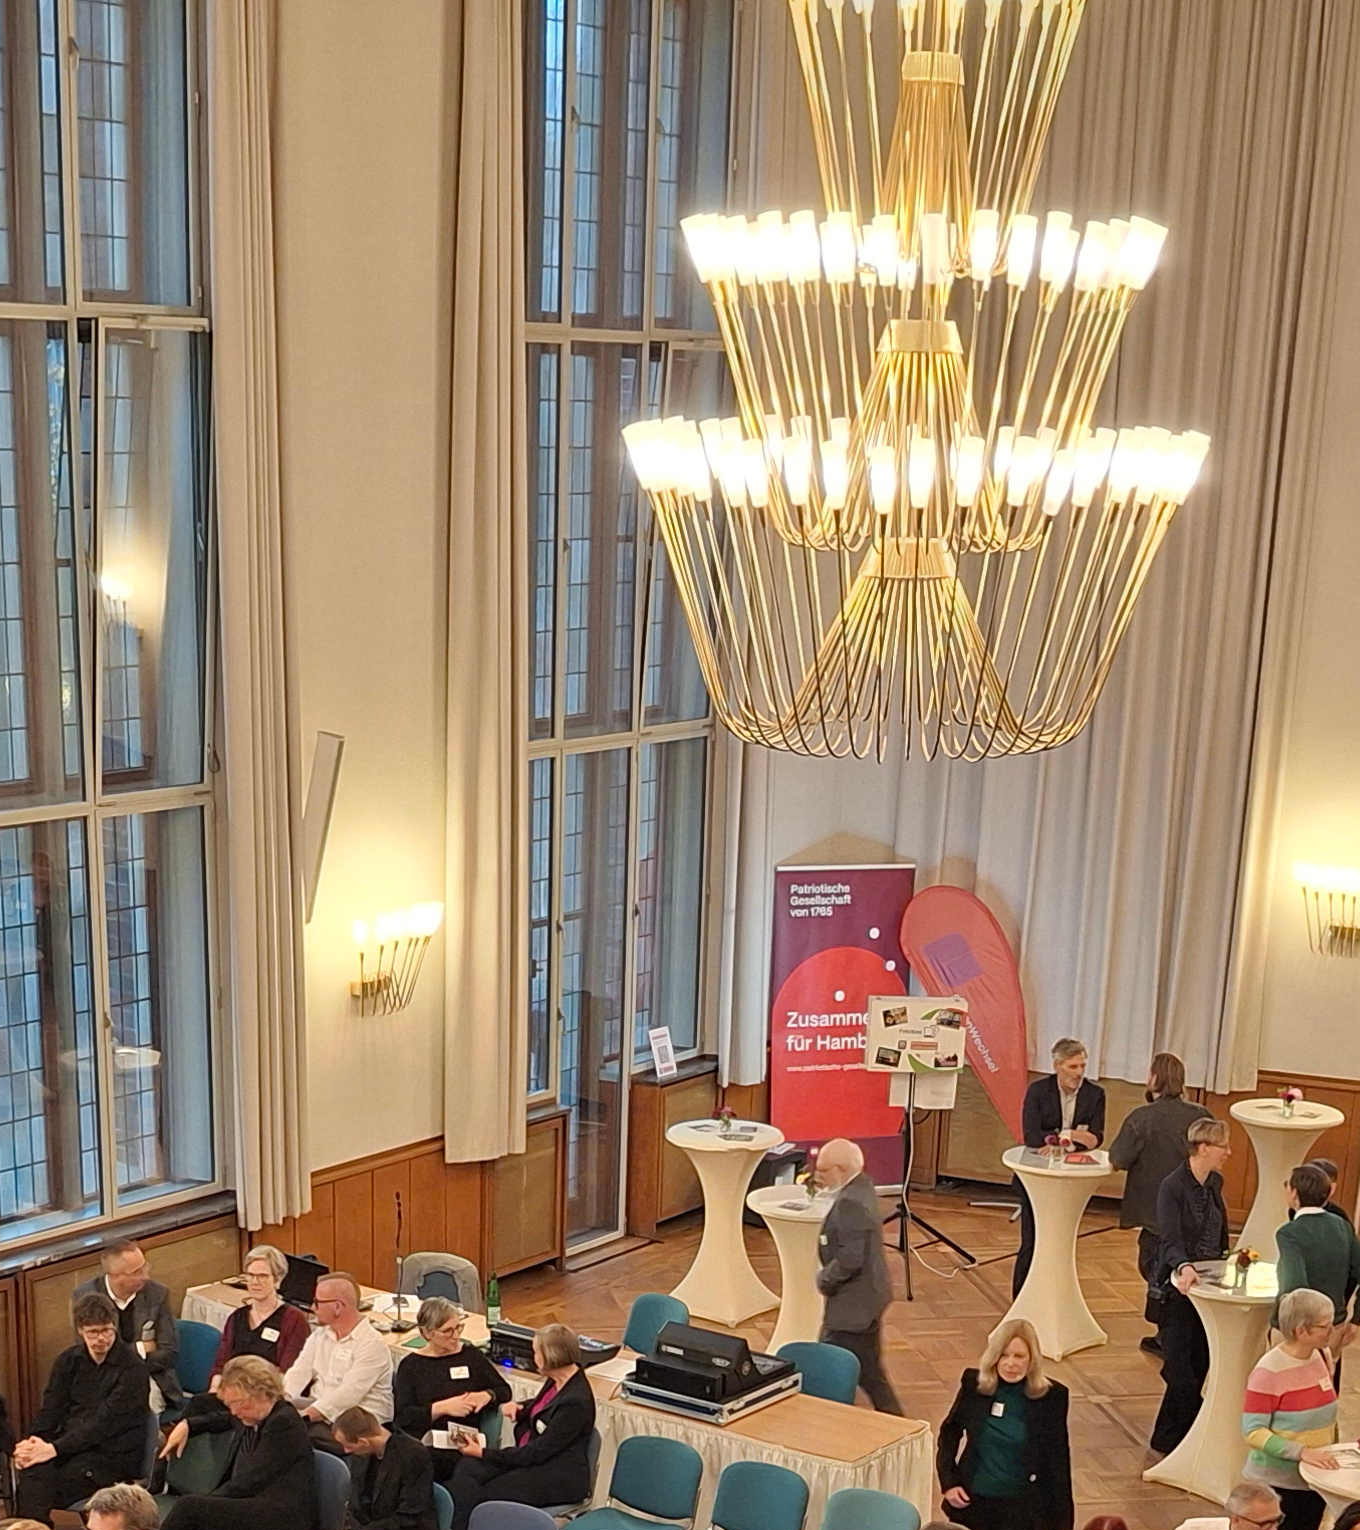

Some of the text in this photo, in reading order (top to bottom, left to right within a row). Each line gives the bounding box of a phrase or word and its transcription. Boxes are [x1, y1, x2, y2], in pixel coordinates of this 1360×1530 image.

[790, 883, 851, 894] Patriotische
[790, 894, 852, 906] Gesellschaft
[790, 908, 809, 917] von
[786, 1034, 813, 1052] für
[966, 1016, 999, 1074] nWechsel
